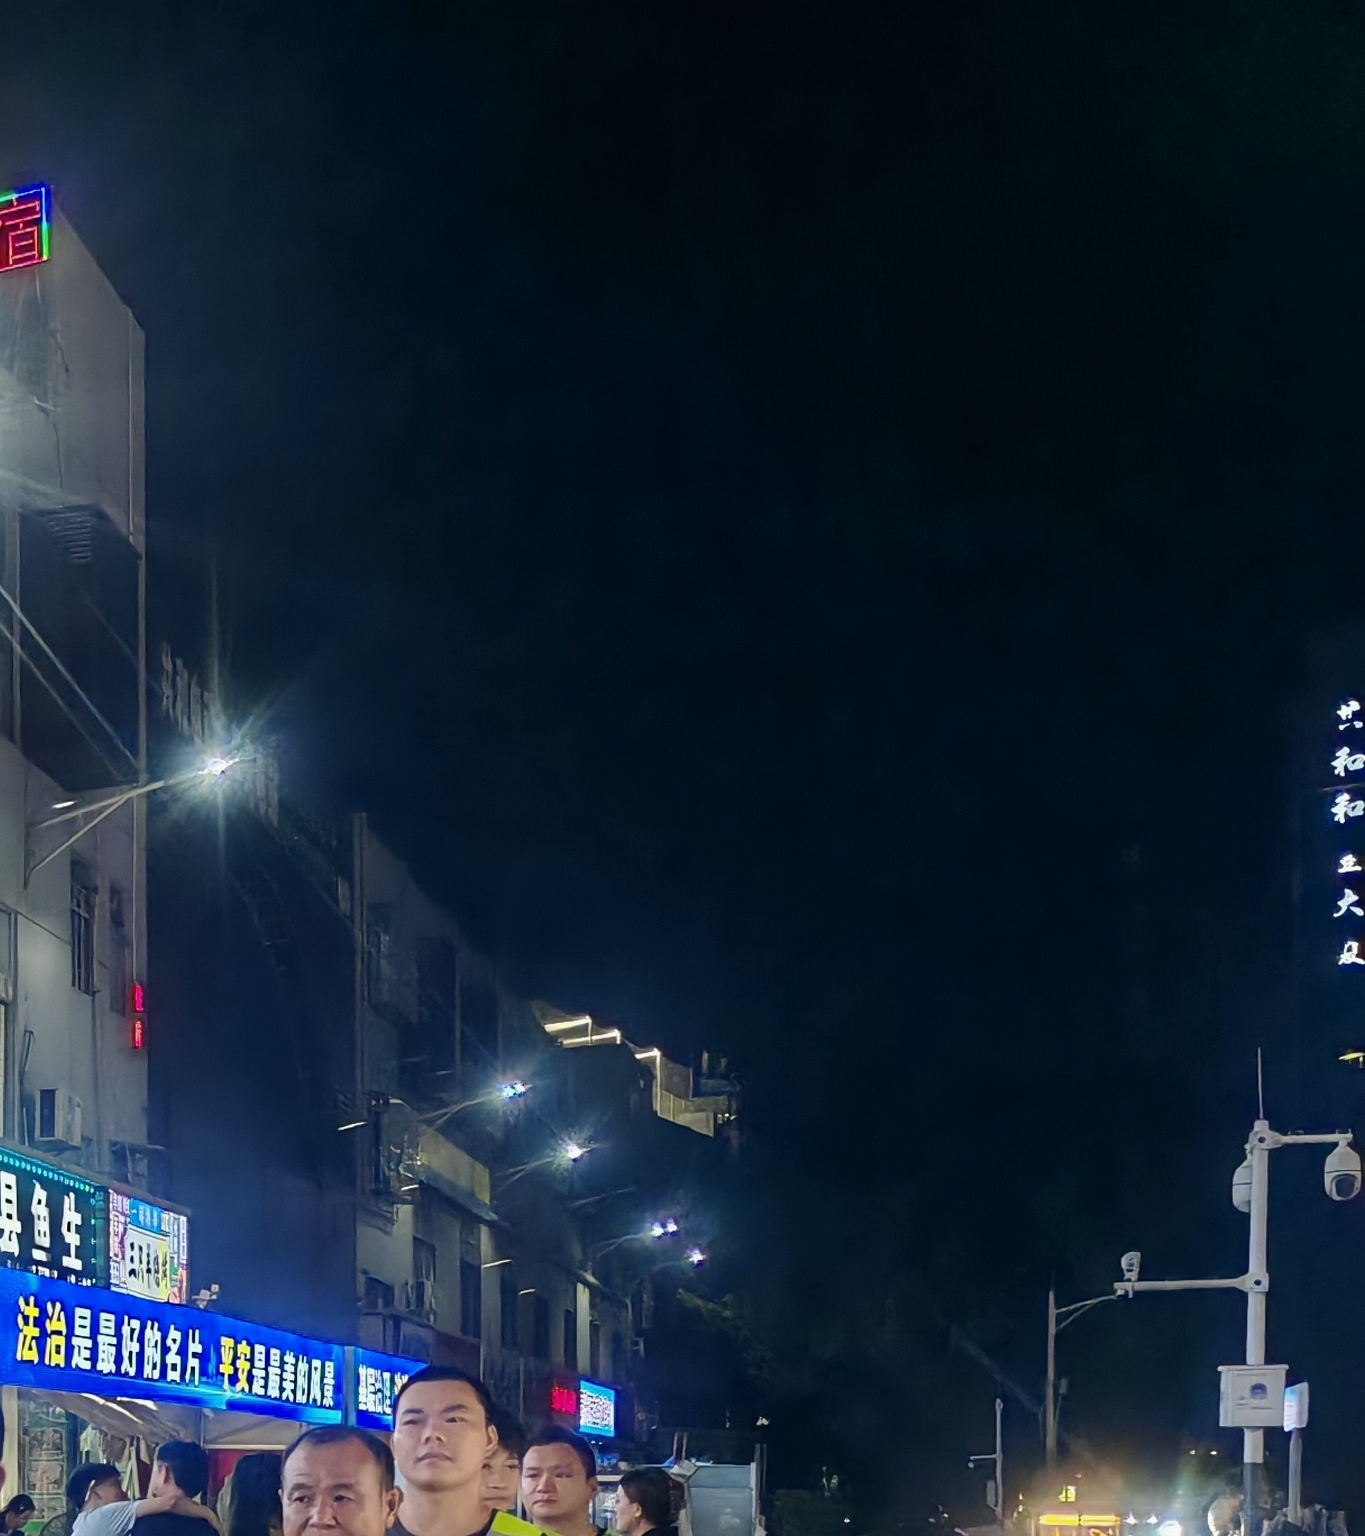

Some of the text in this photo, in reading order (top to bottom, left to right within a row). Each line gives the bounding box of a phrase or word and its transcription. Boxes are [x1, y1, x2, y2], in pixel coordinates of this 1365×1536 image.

[16, 1295, 335, 1407] 法治是最好的名片 平安是最美的风景
